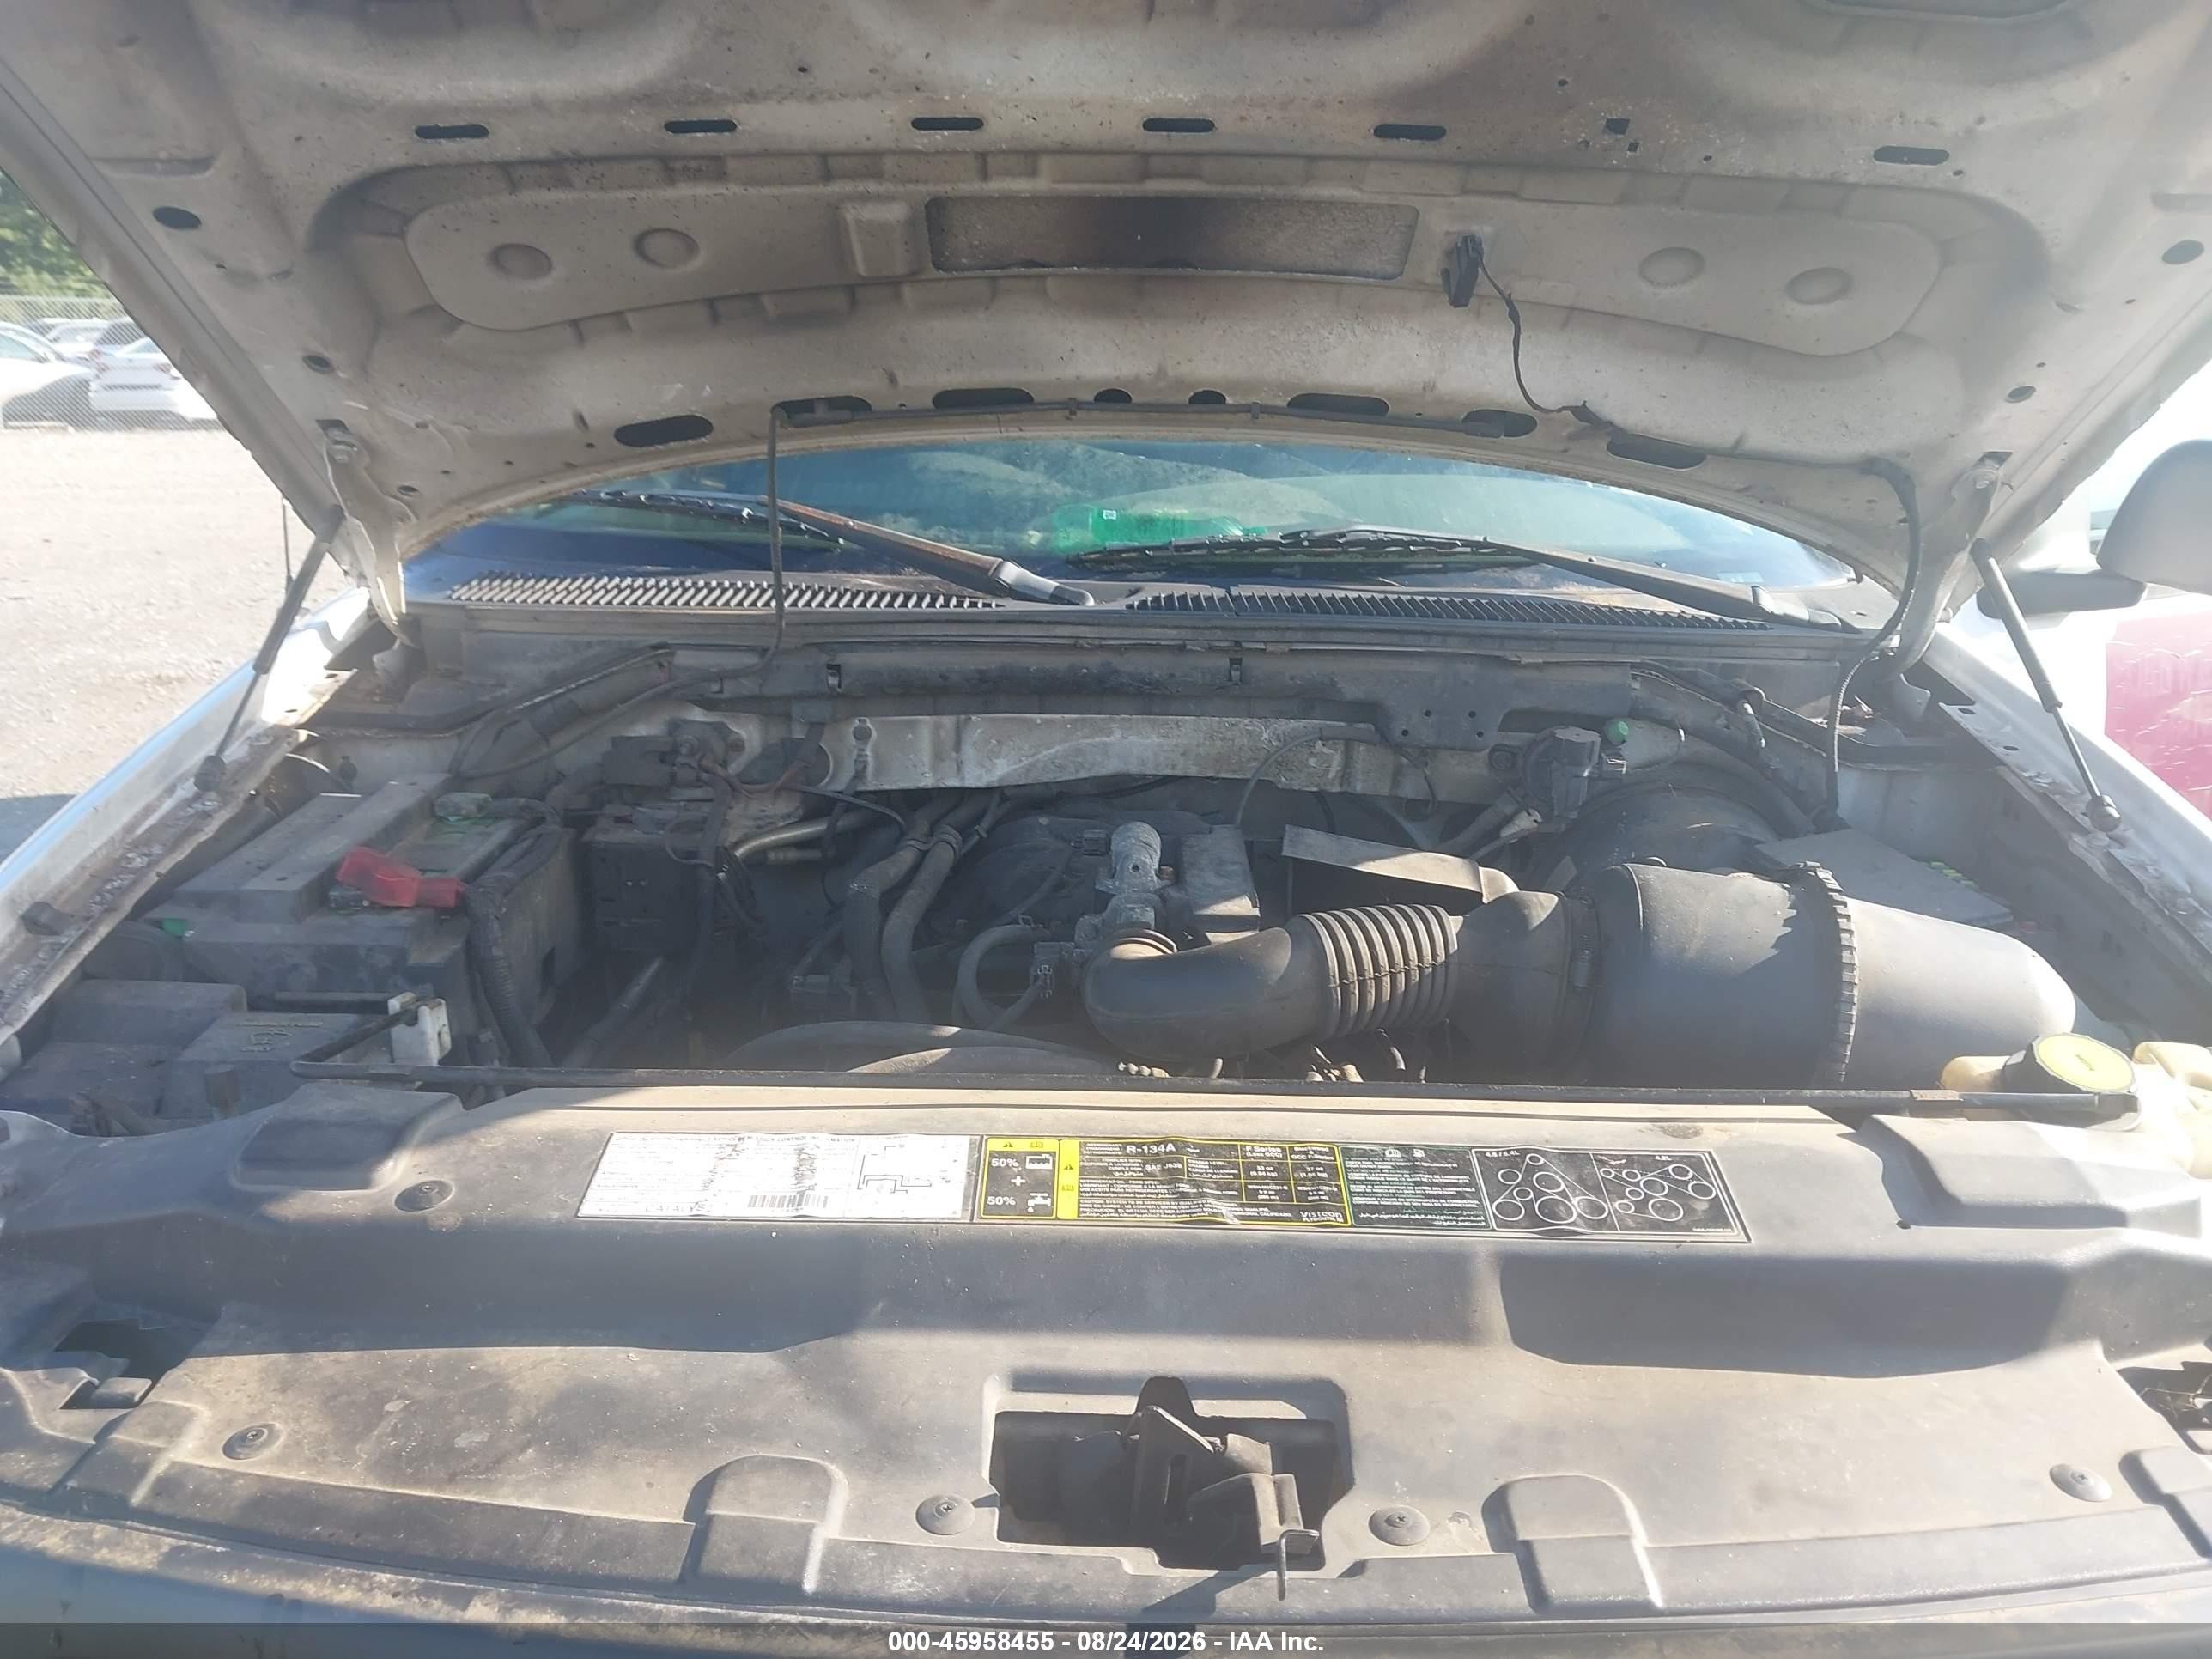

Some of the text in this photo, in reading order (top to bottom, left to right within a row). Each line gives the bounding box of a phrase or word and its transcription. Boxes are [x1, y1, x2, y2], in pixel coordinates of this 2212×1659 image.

[1126, 1143, 1176, 1153] R-134A
[991, 1158, 1019, 1168] 50%
[988, 1196, 1016, 1206] 50%
